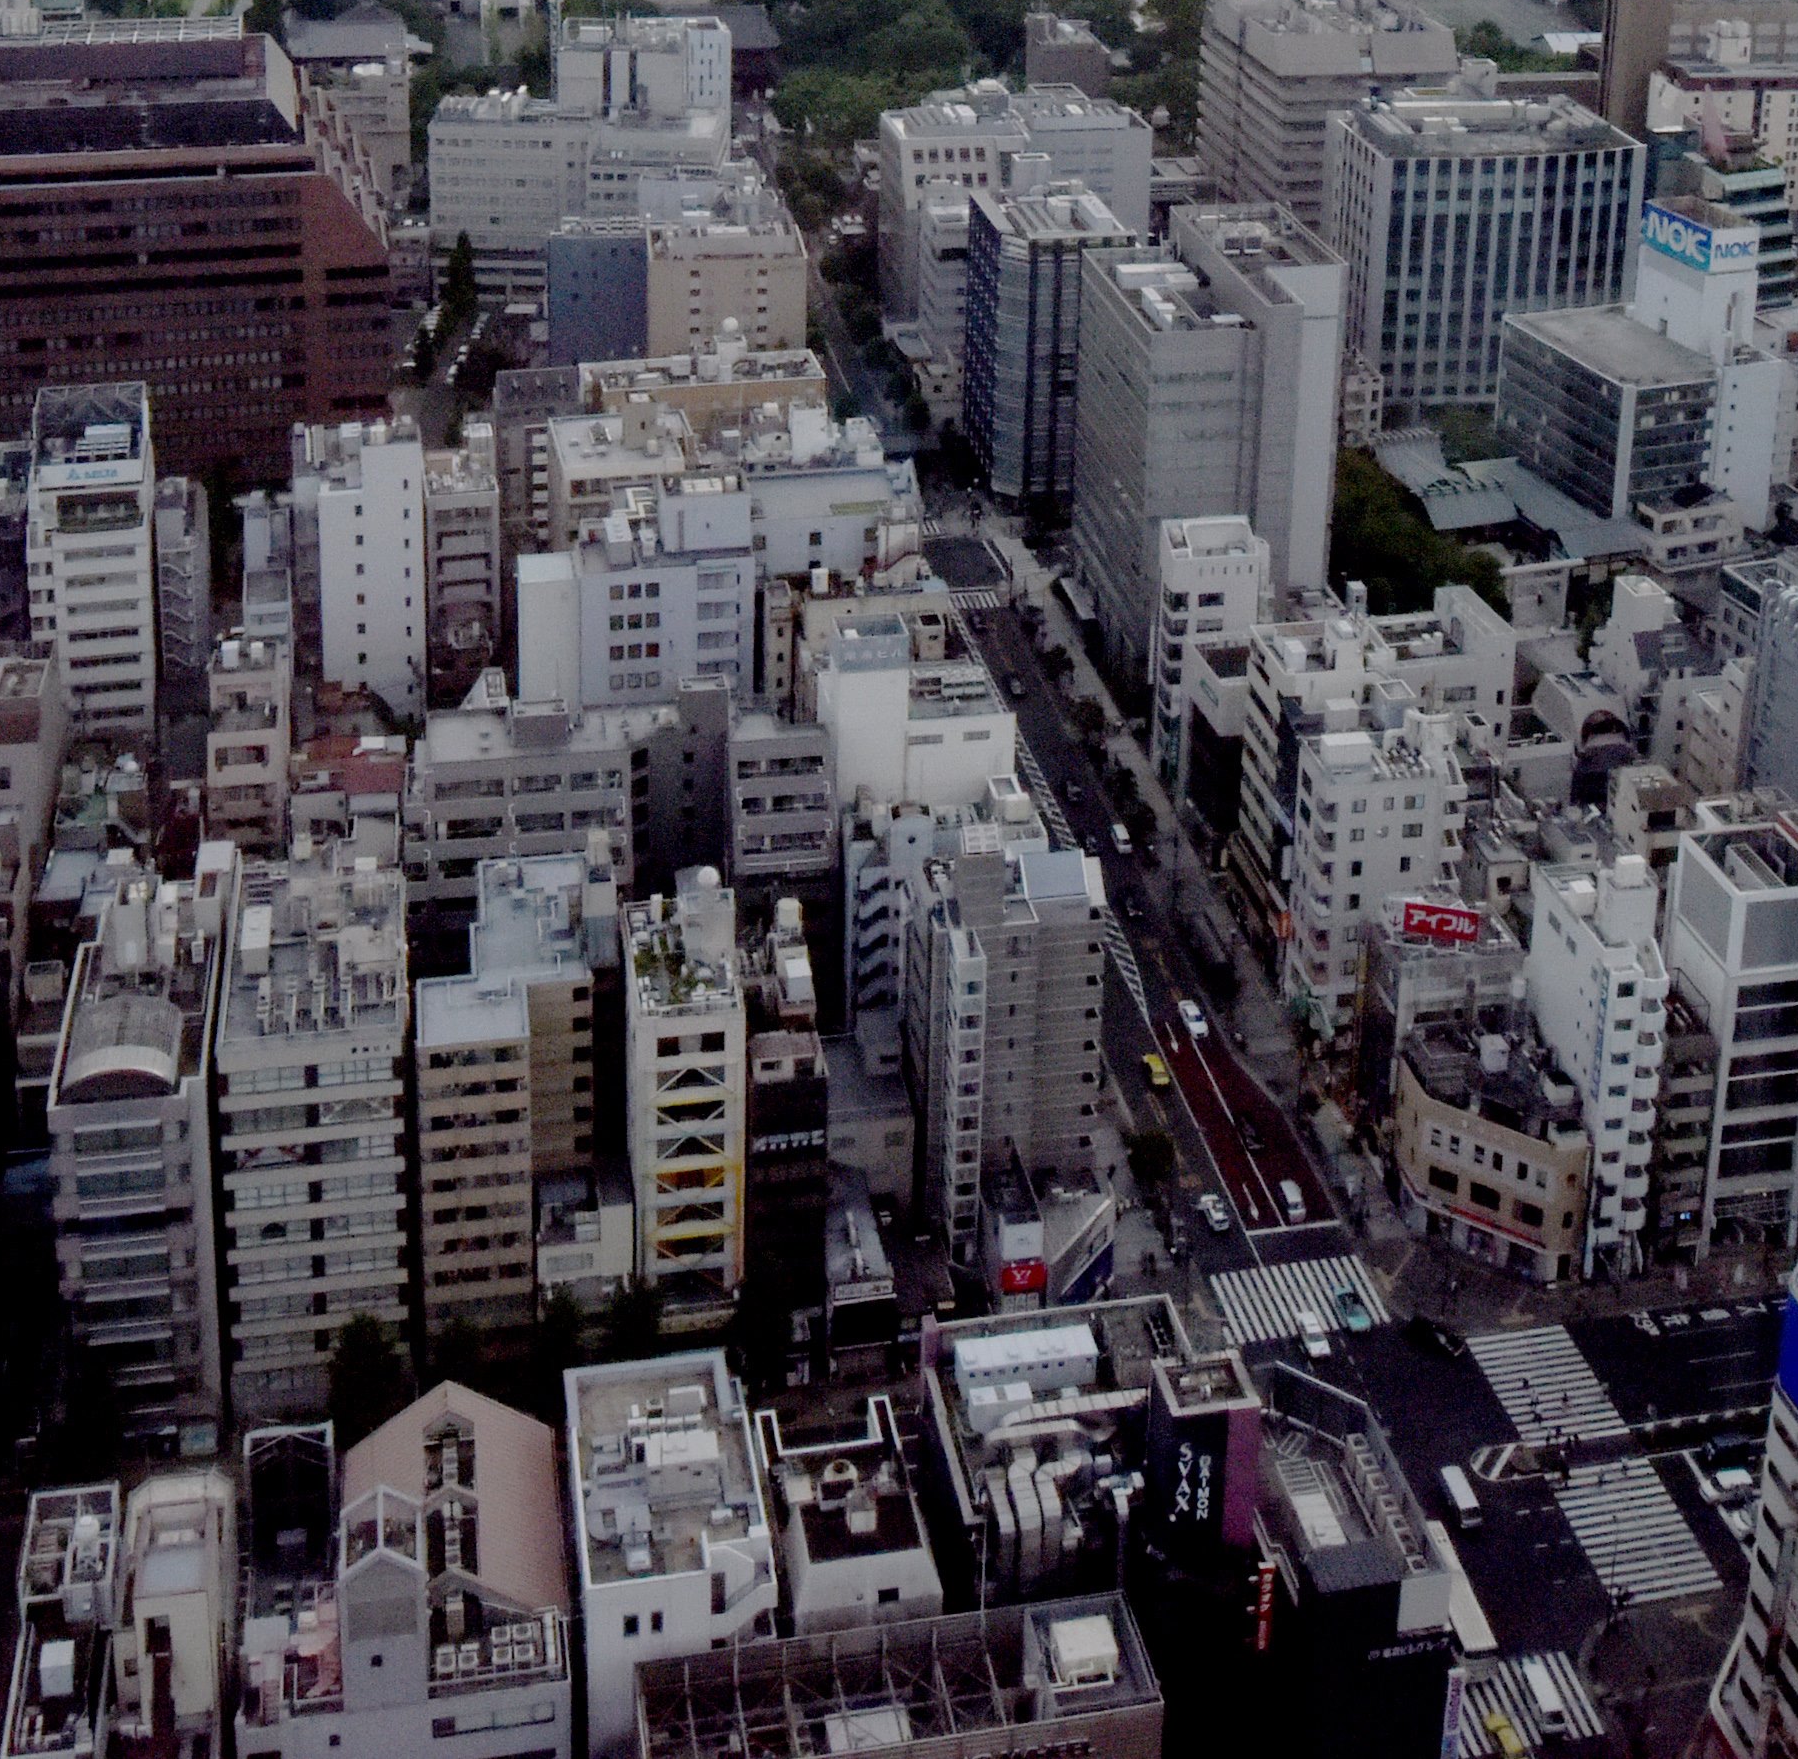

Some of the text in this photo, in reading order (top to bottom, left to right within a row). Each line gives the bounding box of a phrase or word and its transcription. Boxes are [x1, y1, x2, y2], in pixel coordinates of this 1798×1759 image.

[1648, 210, 1708, 263] NOK
[1715, 241, 1756, 259] NOK
[1408, 908, 1476, 934] アイフル
[1195, 1455, 1212, 1521] DAIMON
